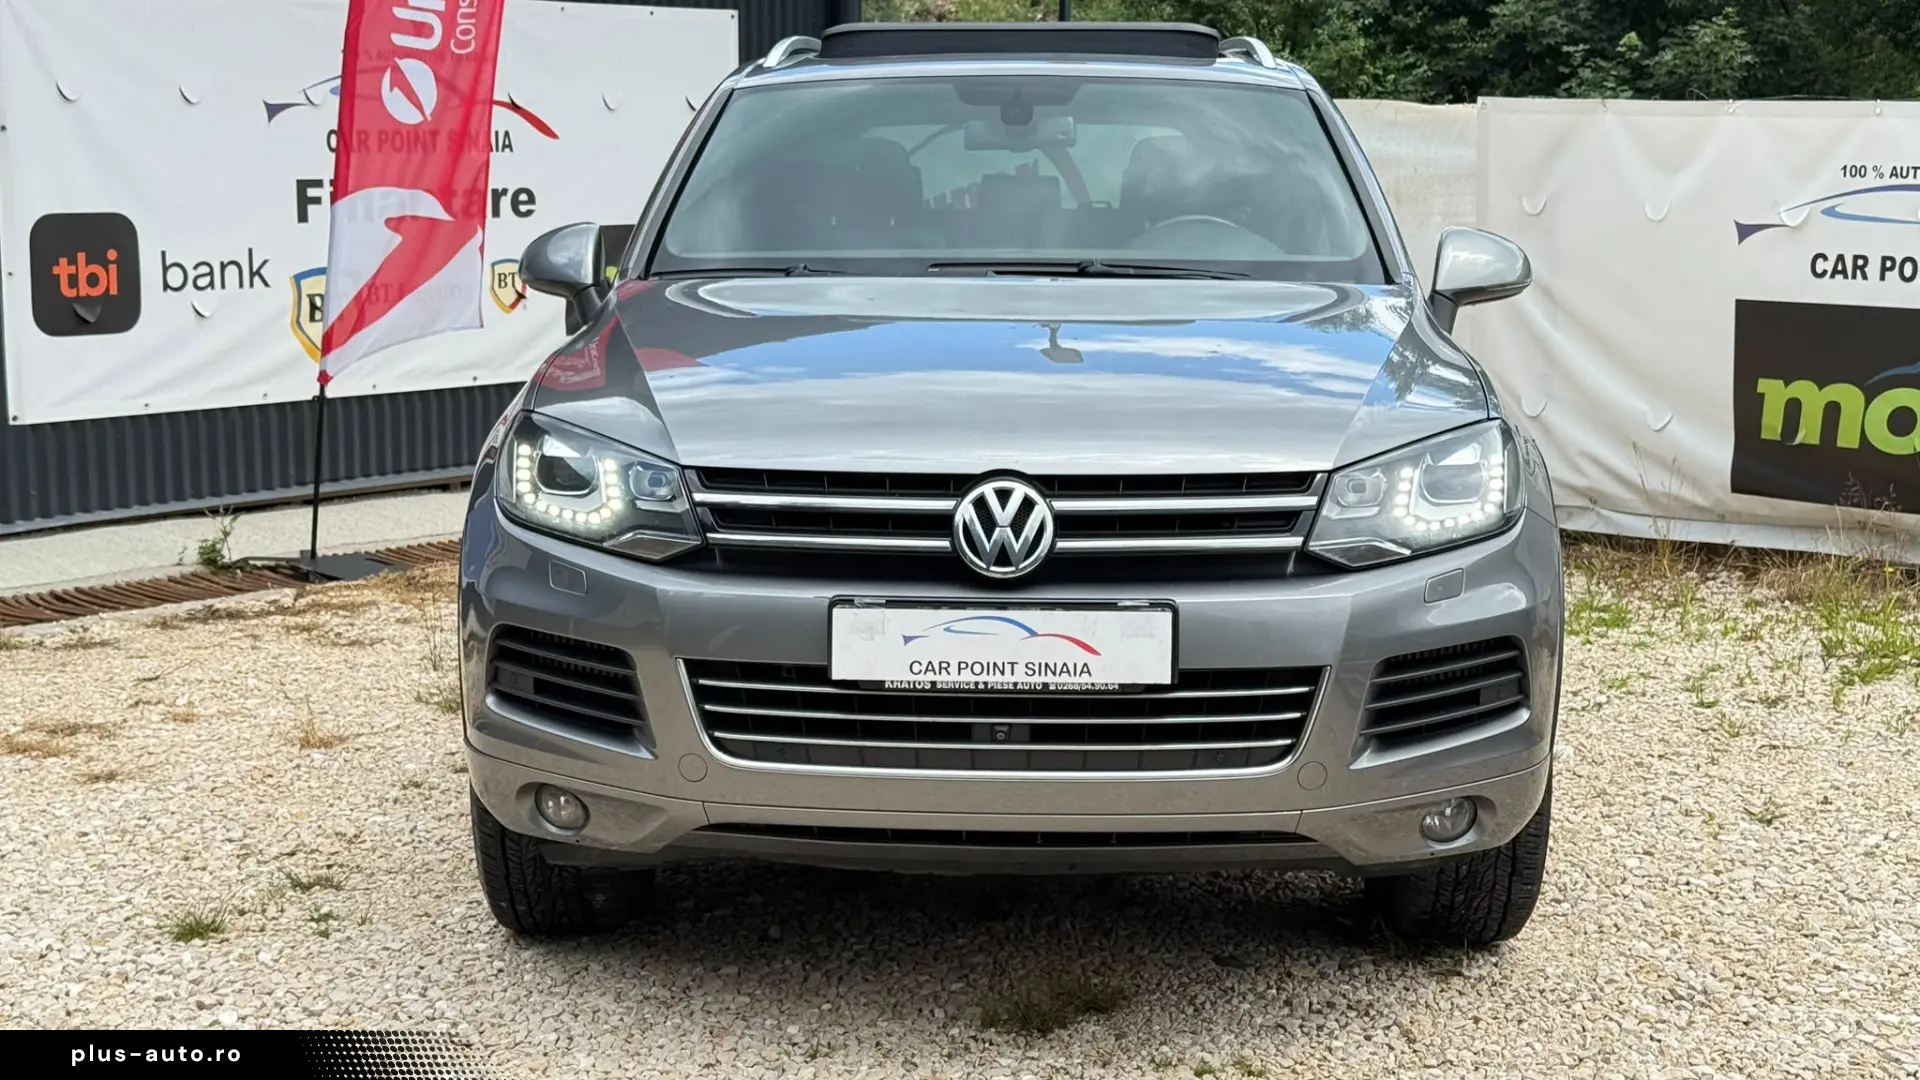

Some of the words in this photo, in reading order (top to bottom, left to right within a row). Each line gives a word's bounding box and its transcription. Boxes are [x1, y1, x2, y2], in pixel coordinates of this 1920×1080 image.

[1840, 164, 1867, 179] 100
[1872, 165, 1885, 180] %
[52, 249, 118, 297] tbi
[160, 248, 271, 292] bank
[1810, 252, 1869, 281] CAR
[497, 273, 518, 289] BT
[909, 660, 952, 676] CAR
[957, 661, 1019, 677] POINT
[1024, 662, 1092, 678] SINAIA
[885, 680, 932, 690] KRATOS
[936, 680, 976, 690] SERVICE
[988, 681, 1015, 690] PIESE
[1017, 681, 1043, 690] AUTO
